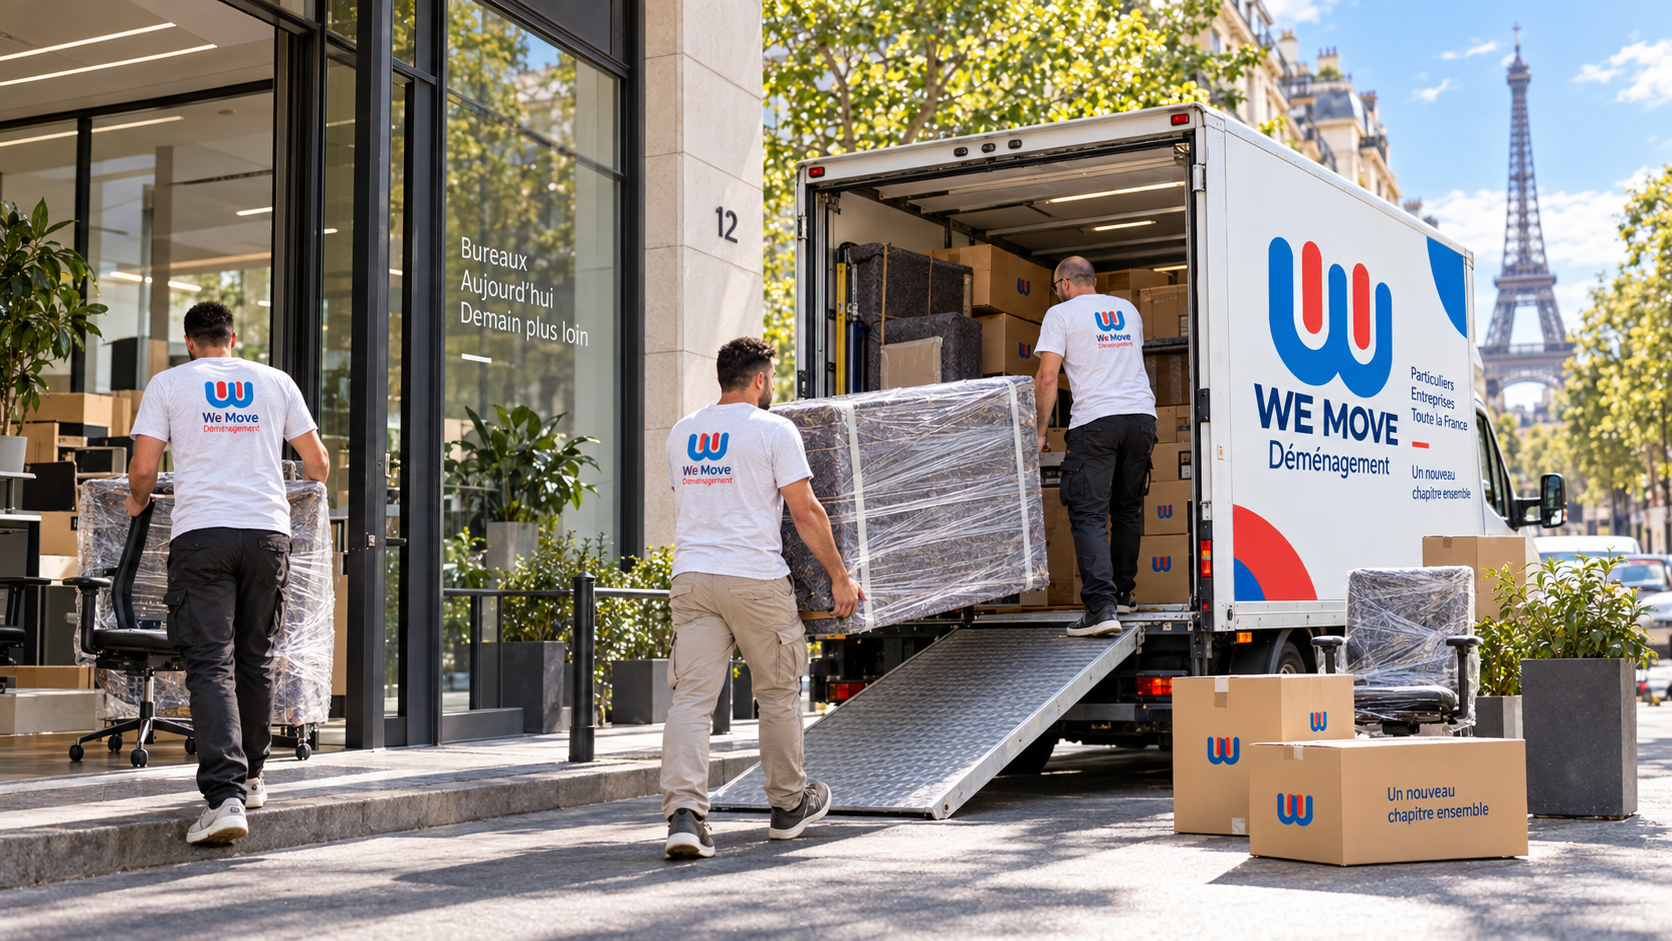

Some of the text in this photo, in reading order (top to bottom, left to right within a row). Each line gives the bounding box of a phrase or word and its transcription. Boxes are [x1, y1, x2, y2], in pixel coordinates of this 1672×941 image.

[715, 205, 738, 244] 12
[461, 236, 528, 272] Bureaux
[461, 269, 554, 309] Aujourd’hui
[461, 301, 588, 347] Demain plus loin
[1096, 333, 1131, 342] We Move
[1411, 366, 1454, 391] Particuliers
[1411, 386, 1455, 410] Entreprises
[202, 412, 259, 423] We Move
[1253, 383, 1399, 447] WE MOVE
[1411, 407, 1468, 431] Toute la France
[682, 465, 732, 476] We Move
[1269, 440, 1390, 479] Déménagement
[1412, 465, 1455, 480] Un nouveau
[1412, 486, 1442, 502] chapitre
[1387, 786, 1455, 802] Un nouveau
[1388, 801, 1489, 825] chapitre ensemble
